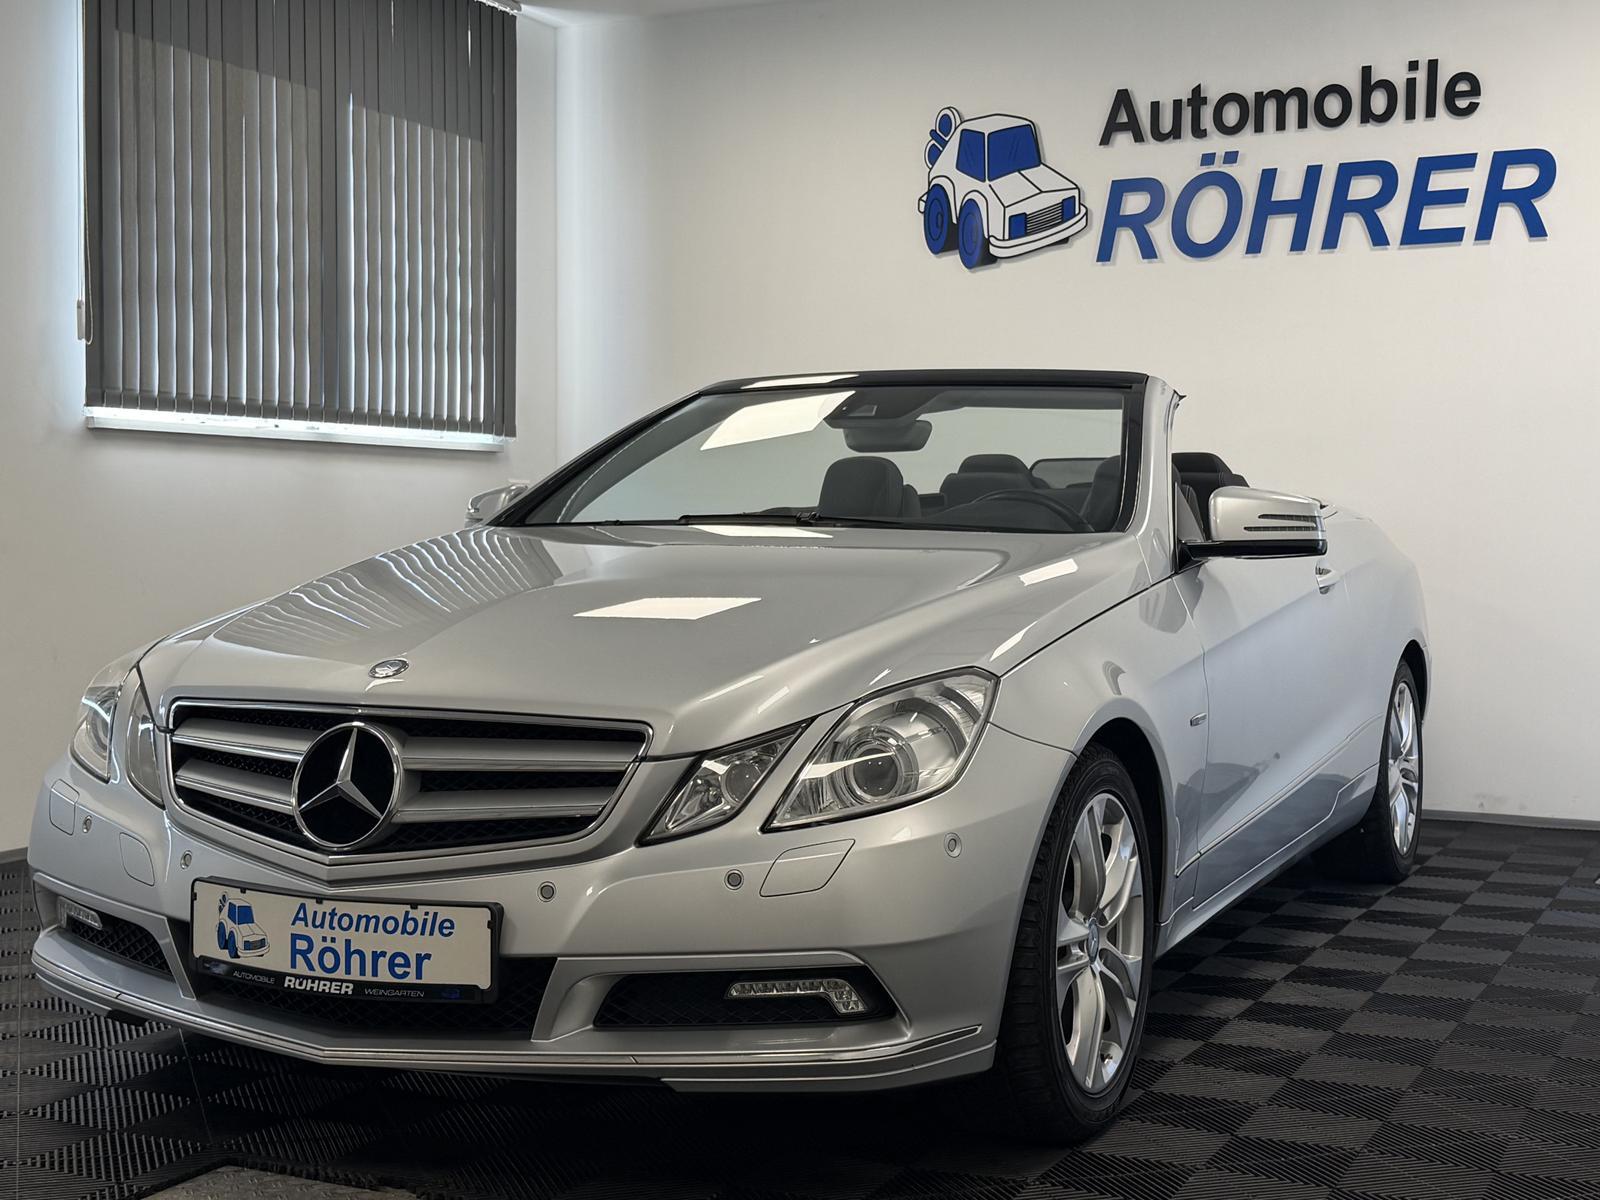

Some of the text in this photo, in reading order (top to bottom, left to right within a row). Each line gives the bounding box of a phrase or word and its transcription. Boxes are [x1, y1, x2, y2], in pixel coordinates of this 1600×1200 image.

[1099, 59, 1482, 146] Automobile
[1095, 148, 1558, 264] RÖHRER
[291, 902, 455, 938] Automobile
[290, 932, 432, 981] Röhrer
[233, 970, 275, 985] AUTOMOBILE
[364, 987, 425, 998] WEINGARTEN
